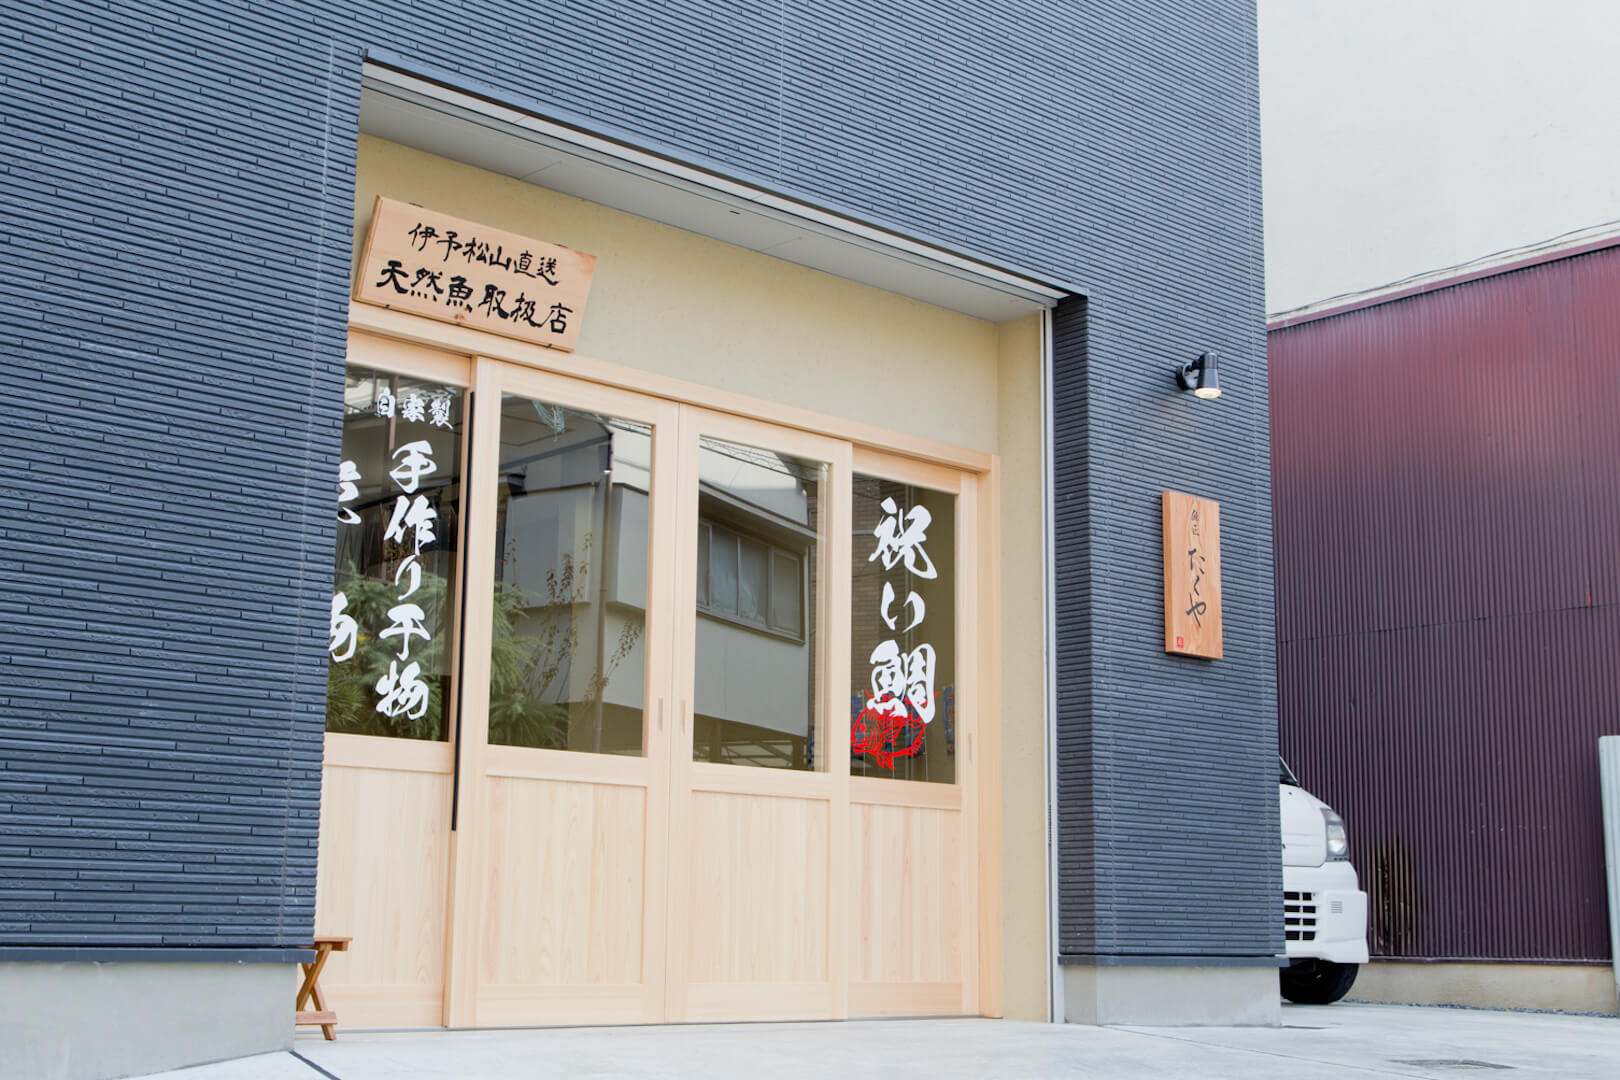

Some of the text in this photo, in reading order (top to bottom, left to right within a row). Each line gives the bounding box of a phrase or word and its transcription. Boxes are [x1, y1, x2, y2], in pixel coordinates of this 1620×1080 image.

[408, 222, 560, 286] 伊予松山直送
[376, 260, 574, 334] 天然魚取扱店
[868, 496, 938, 724] 祝い鯛
[1186, 548, 1207, 628] たくや
